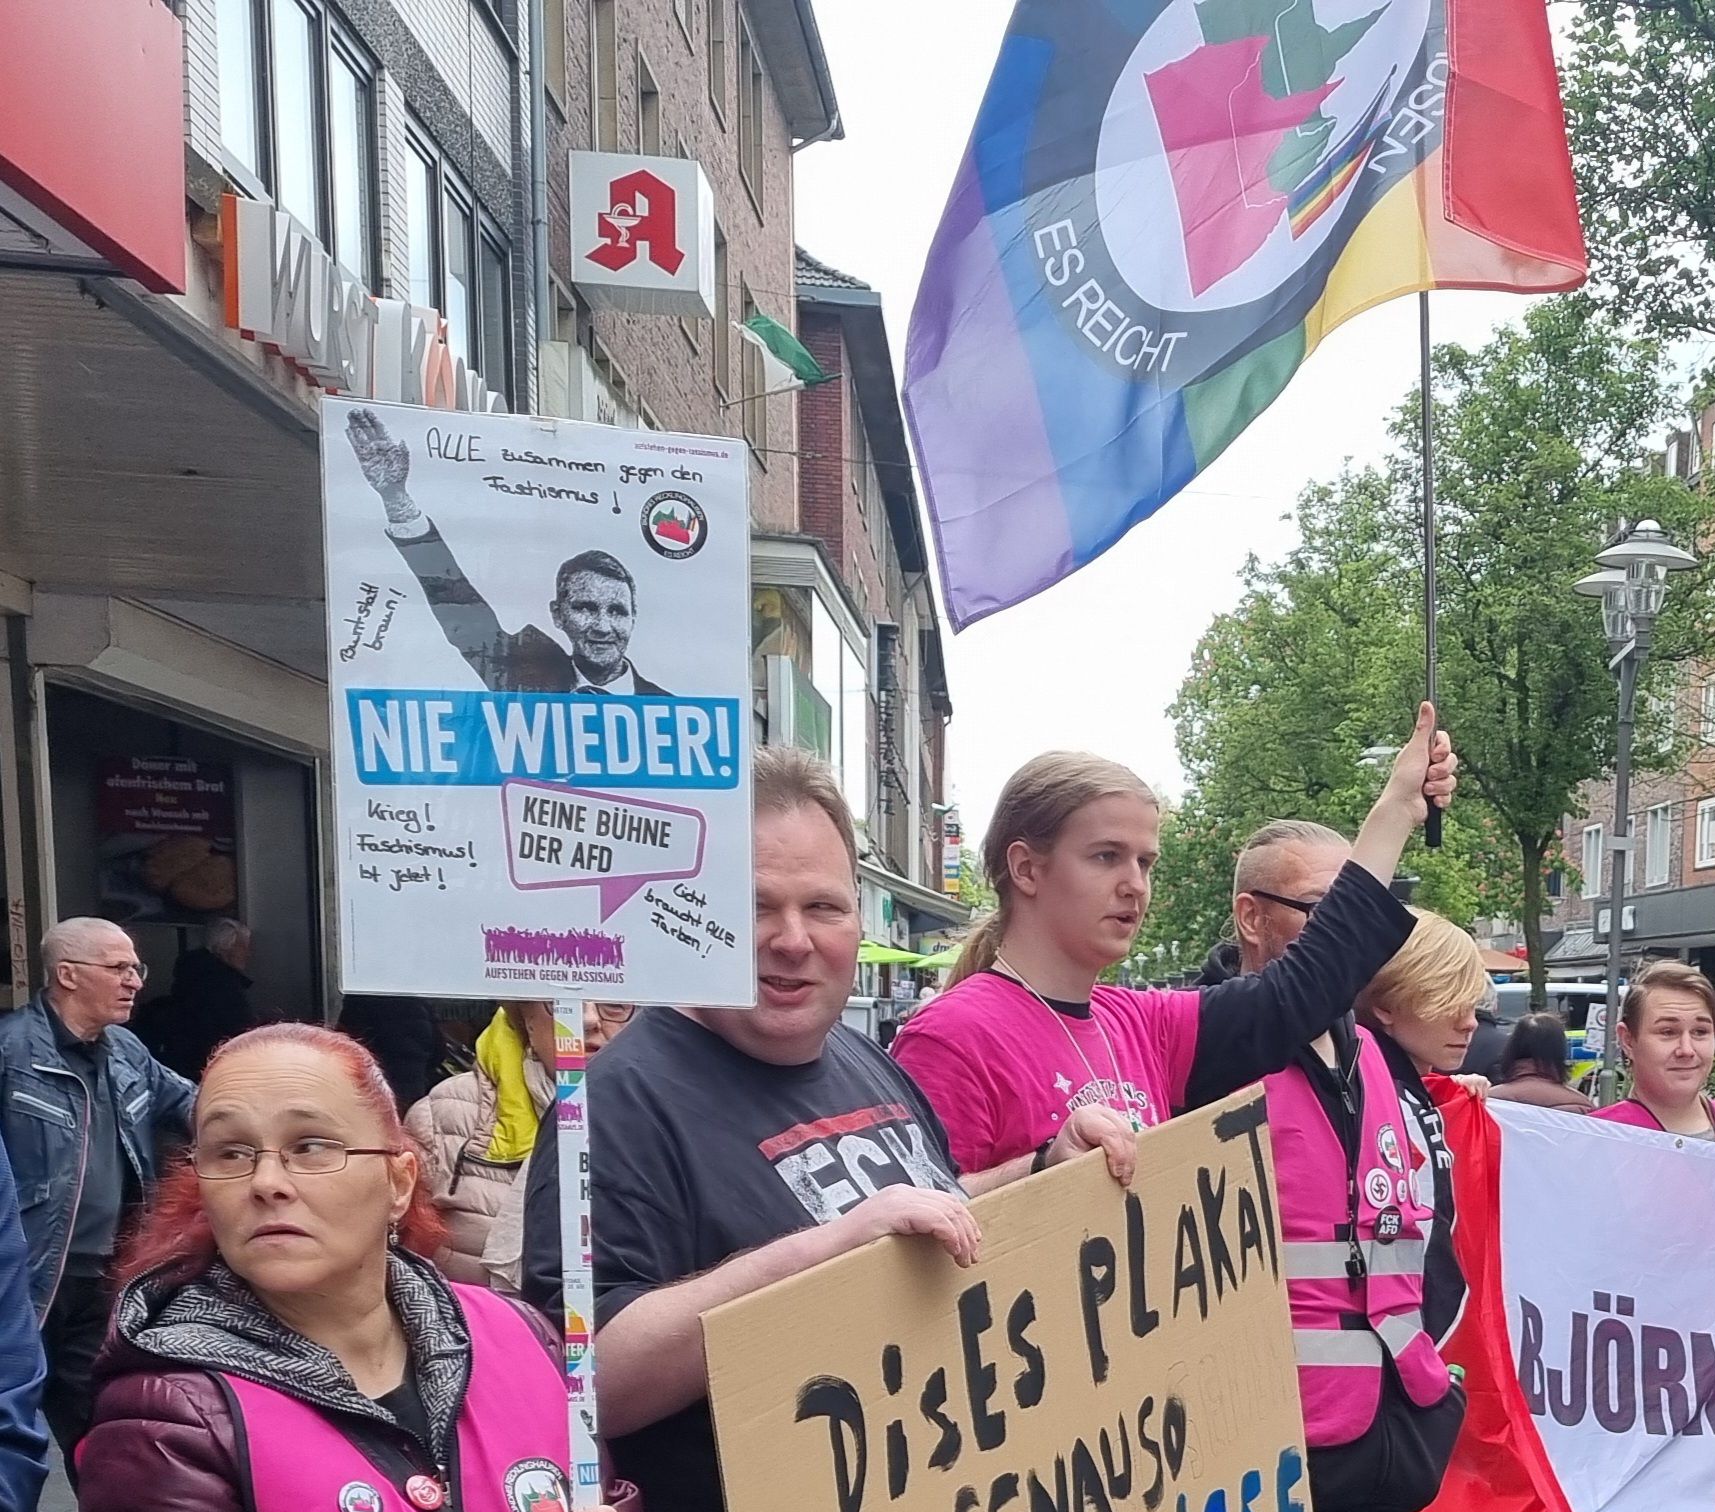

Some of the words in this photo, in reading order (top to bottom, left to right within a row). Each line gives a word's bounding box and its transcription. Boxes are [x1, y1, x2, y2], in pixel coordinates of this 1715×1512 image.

[1032, 218, 1085, 287] ES
[1062, 277, 1188, 372] REICHT
[426, 427, 486, 463] ALLE
[501, 449, 605, 473] zusammen
[619, 465, 664, 485] gegen
[671, 464, 703, 483] den
[358, 699, 457, 773] NIE
[482, 701, 732, 777] WIEDER!
[367, 799, 436, 833] Krieg!
[522, 796, 587, 834] KEINE
[596, 801, 672, 849] BÜHNE
[356, 833, 477, 868] Faschismus!
[518, 832, 562, 864] DER
[570, 844, 613, 873] AFD
[705, 920, 736, 949] ALLE
[484, 966, 536, 981] AUFSTEHEN
[539, 968, 568, 983] GEGEN
[571, 969, 624, 985] RASSISMUS
[774, 1123, 961, 1226] FCK
[1379, 1224, 1398, 1235] AFD
[1380, 1213, 1400, 1226] FCK
